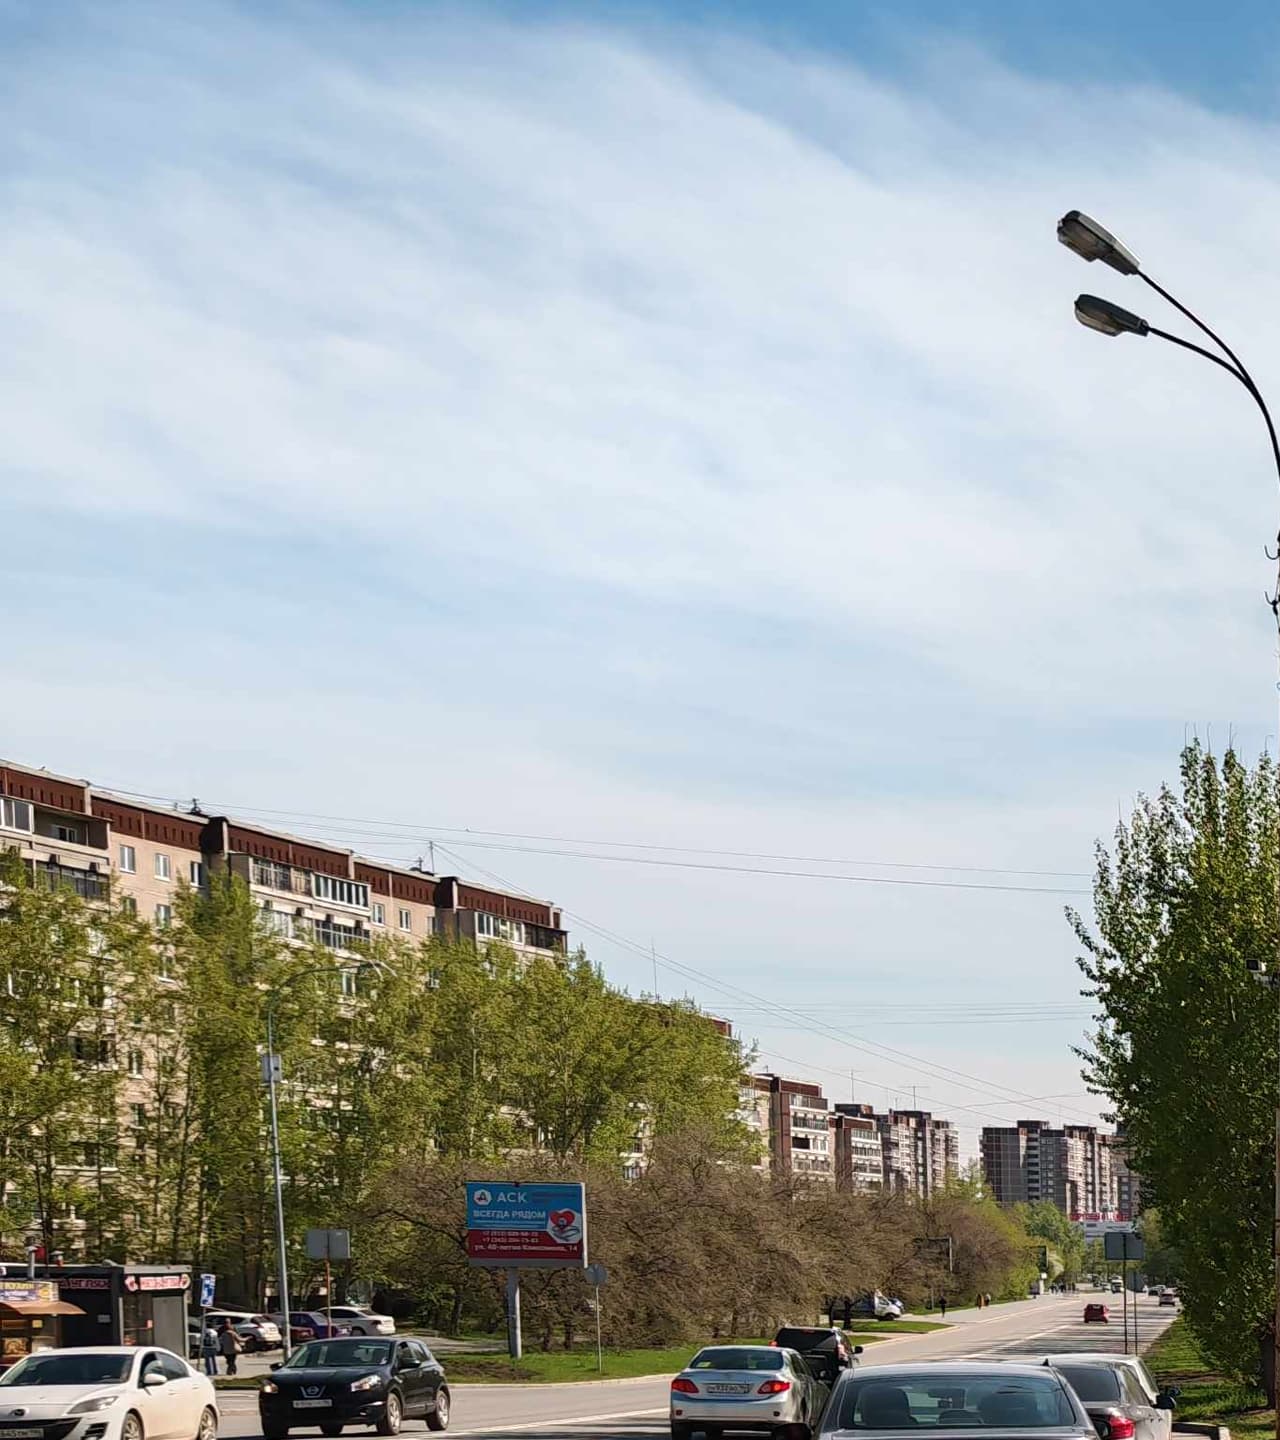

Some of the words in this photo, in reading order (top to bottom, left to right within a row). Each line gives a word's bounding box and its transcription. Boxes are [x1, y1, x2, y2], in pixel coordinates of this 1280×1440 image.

[497, 1192, 528, 1203] АСК
[473, 1210, 510, 1219] ВСЕГДА
[511, 1210, 545, 1219] РЯДОМ
